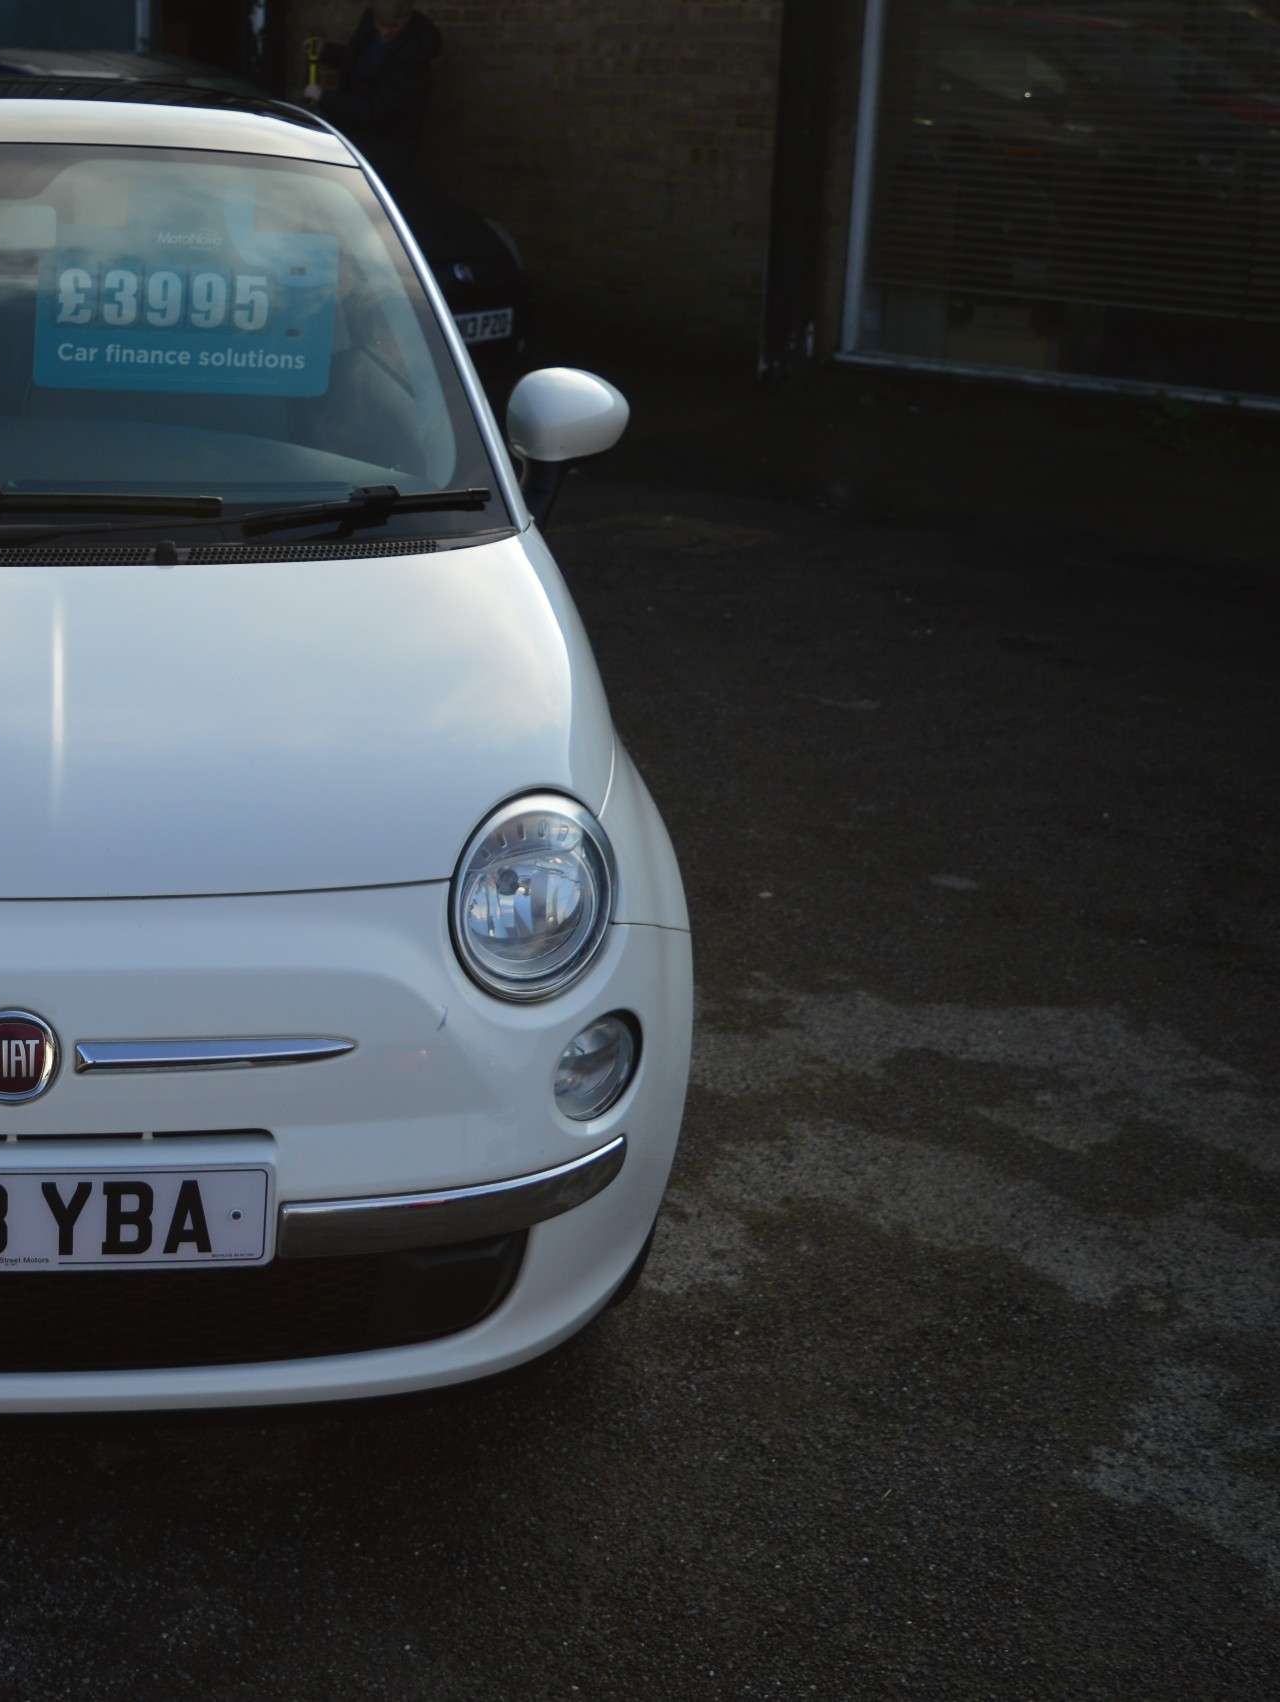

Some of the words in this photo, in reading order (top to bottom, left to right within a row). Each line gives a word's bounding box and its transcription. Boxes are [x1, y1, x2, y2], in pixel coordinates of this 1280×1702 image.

[56, 268, 268, 331] £3995
[57, 343, 98, 362] Car
[105, 344, 191, 366] finance
[199, 348, 305, 370] solutions
[41, 1179, 212, 1255] YBA
[23, 1256, 49, 1264] Motors
